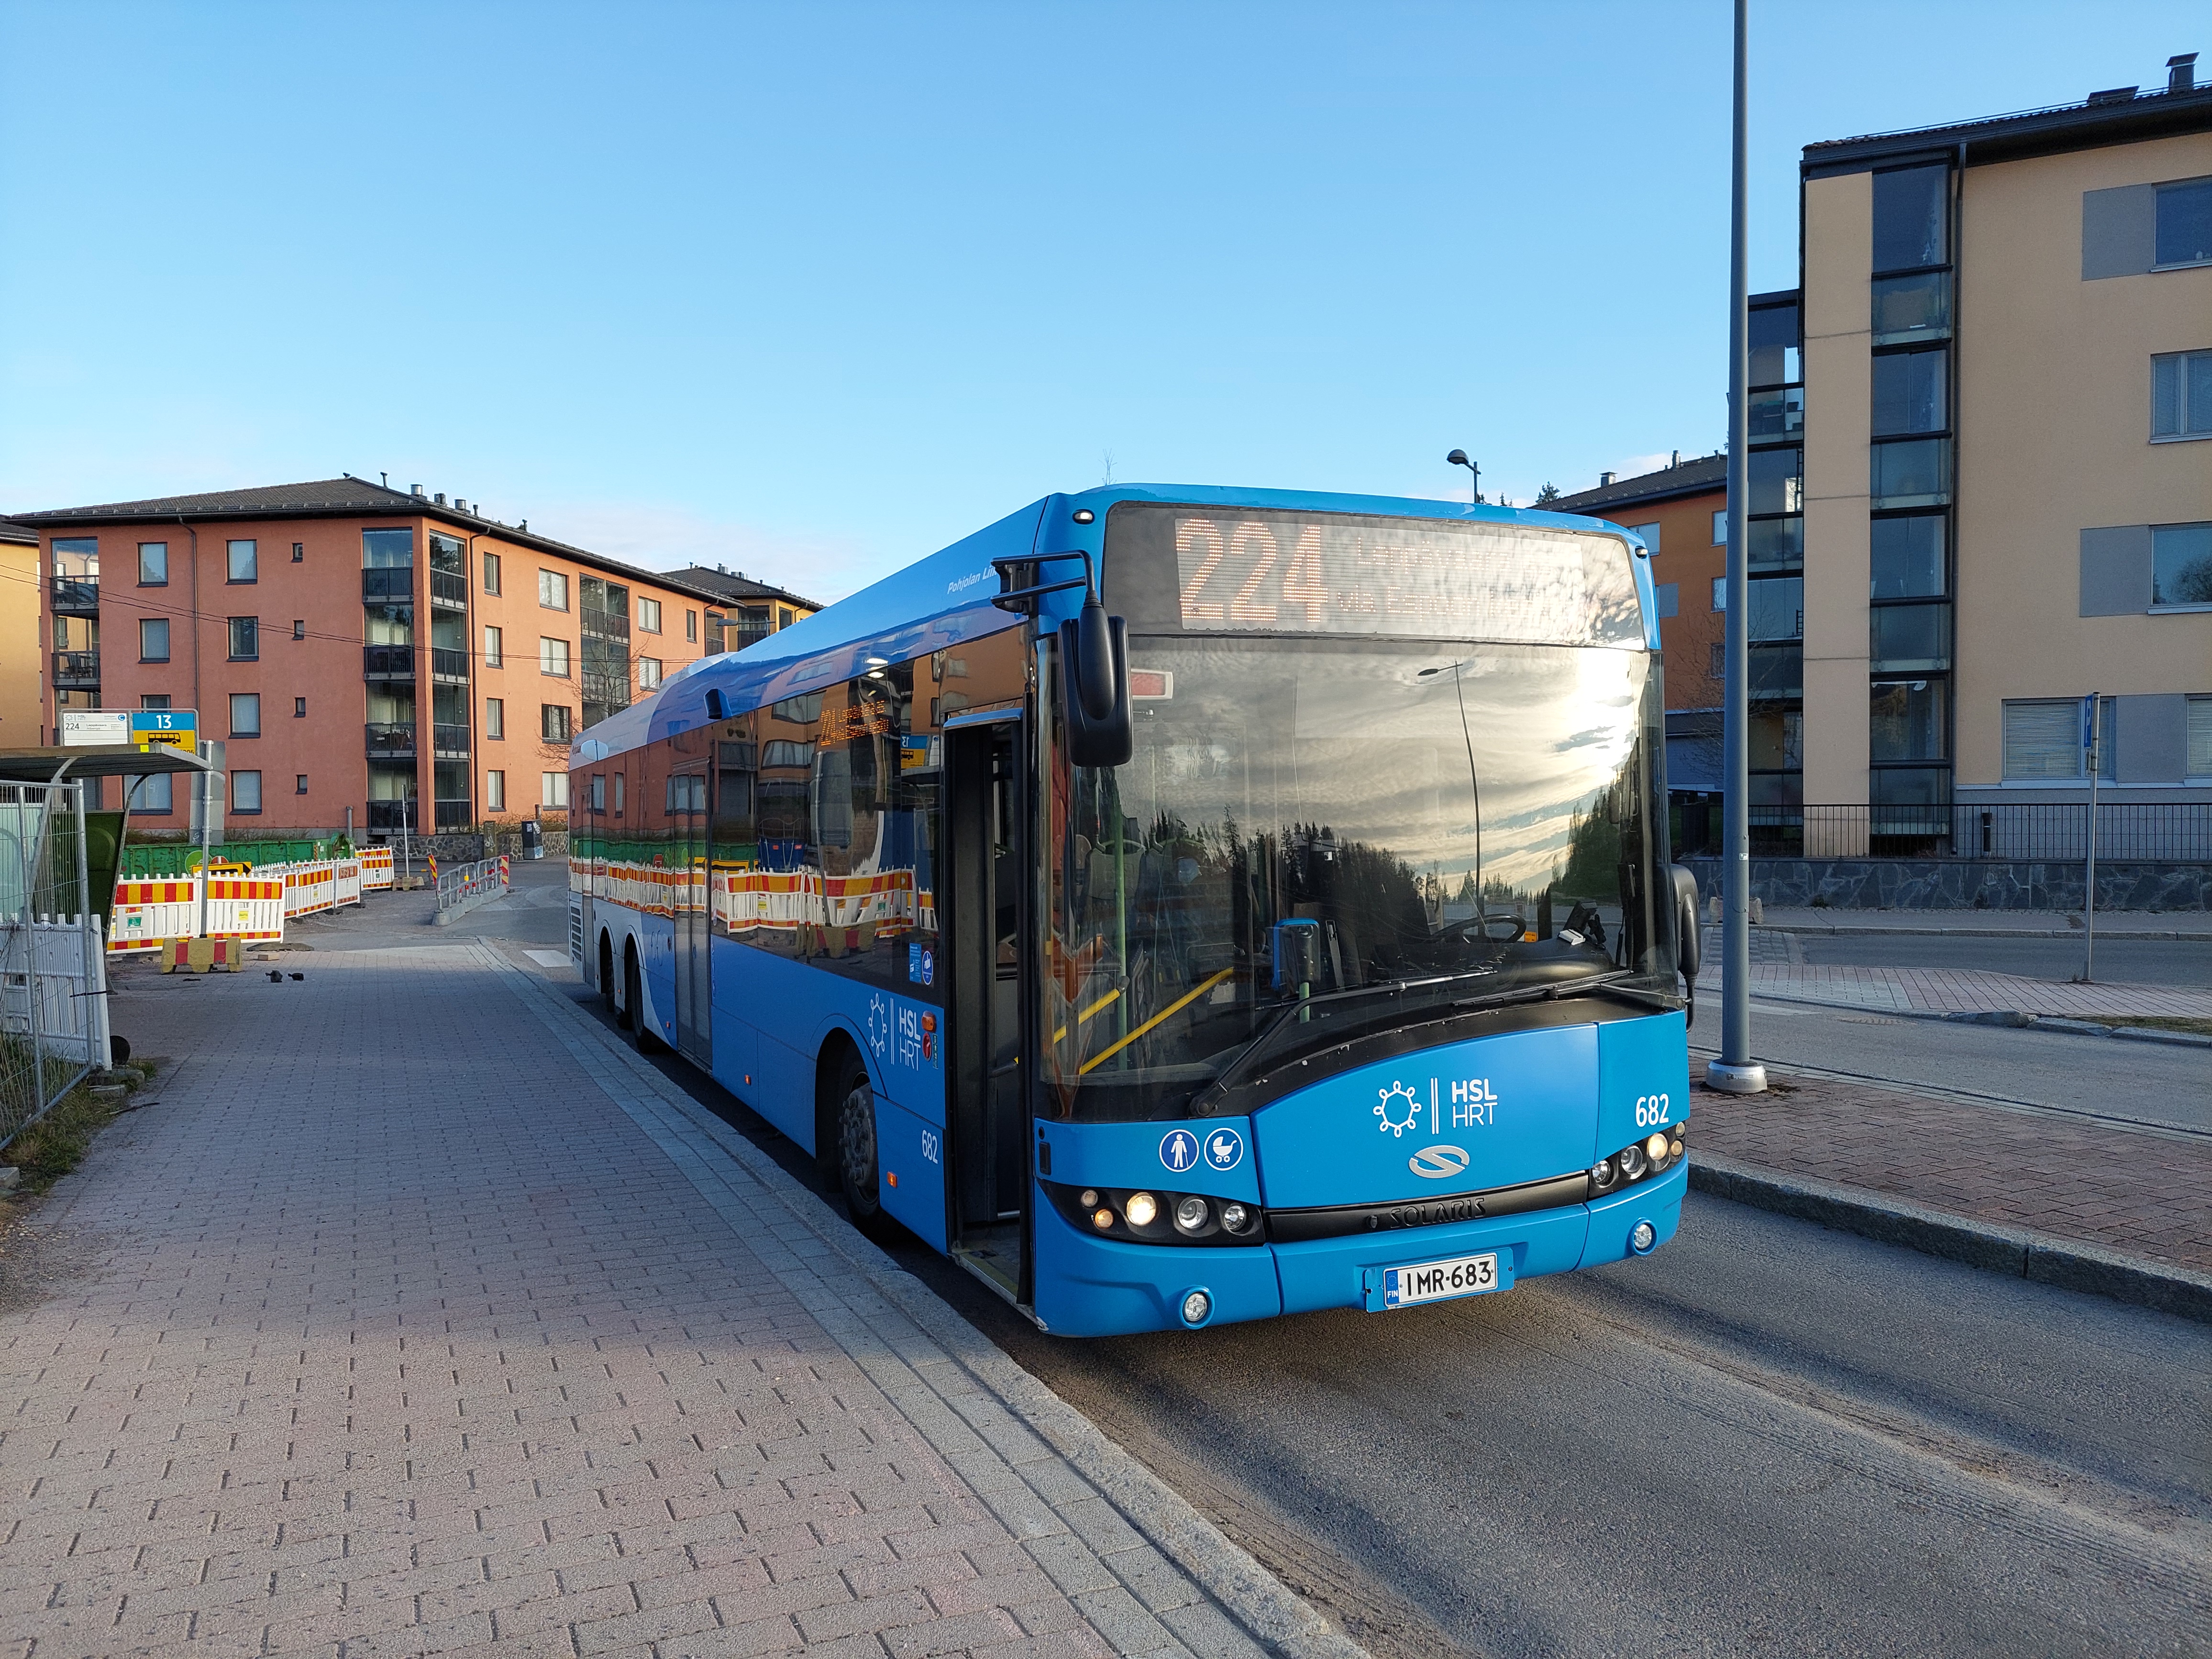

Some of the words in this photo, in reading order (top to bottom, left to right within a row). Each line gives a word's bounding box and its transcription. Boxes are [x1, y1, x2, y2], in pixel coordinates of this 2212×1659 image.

[947, 573, 981, 595] Pohjolan
[1176, 519, 1328, 622] 224
[1337, 584, 1376, 613] via
[156, 715, 172, 729] 13
[2085, 700, 2091, 744] P
[899, 1006, 921, 1041] HSL
[899, 1036, 921, 1071] HRT
[1451, 1078, 1498, 1103] HSL
[1452, 1102, 1498, 1128] HRT
[1636, 1093, 1669, 1127] 682
[922, 1129, 938, 1164] 682
[1390, 1197, 1486, 1228] SOLARIS
[1387, 1290, 1398, 1298] FIN
[1407, 1261, 1492, 1296] IMR-683
